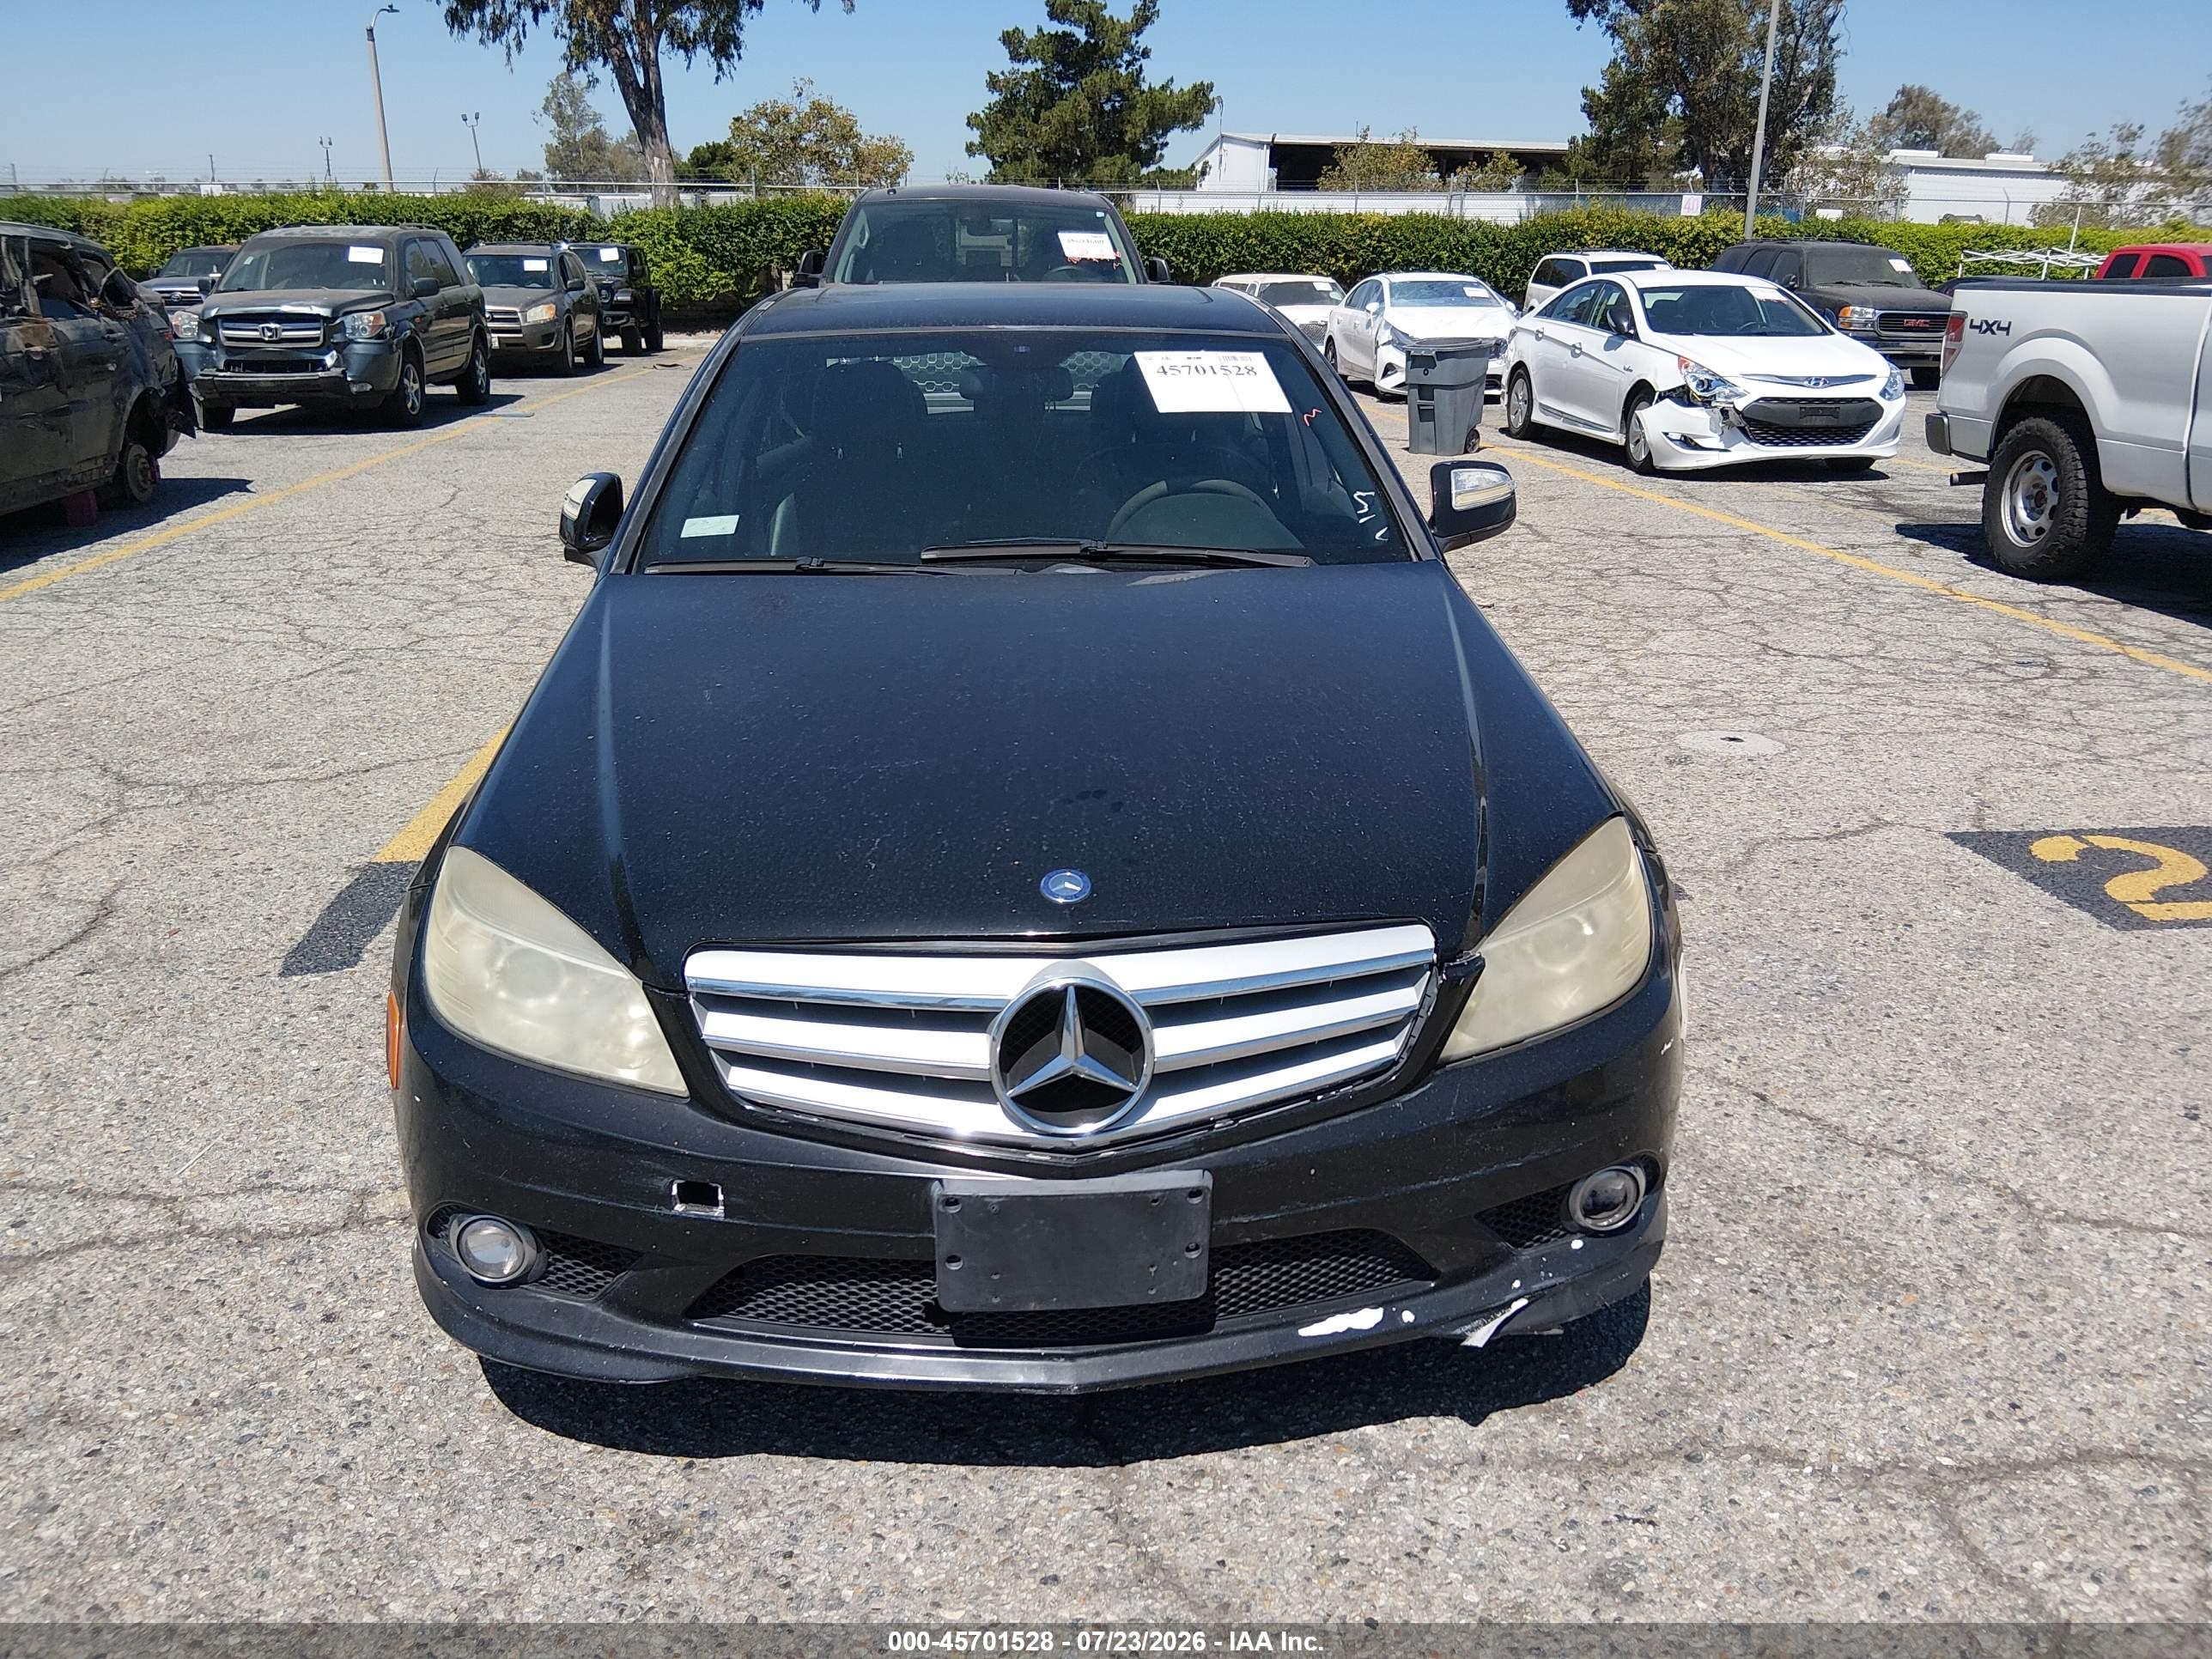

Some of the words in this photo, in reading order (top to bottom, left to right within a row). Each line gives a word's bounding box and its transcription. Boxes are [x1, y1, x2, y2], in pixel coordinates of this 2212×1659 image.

[1903, 319, 1930, 328] GMC
[1968, 318, 2013, 337] 4X4
[1156, 364, 1258, 377] 45701528
[2029, 835, 2212, 922] 2
